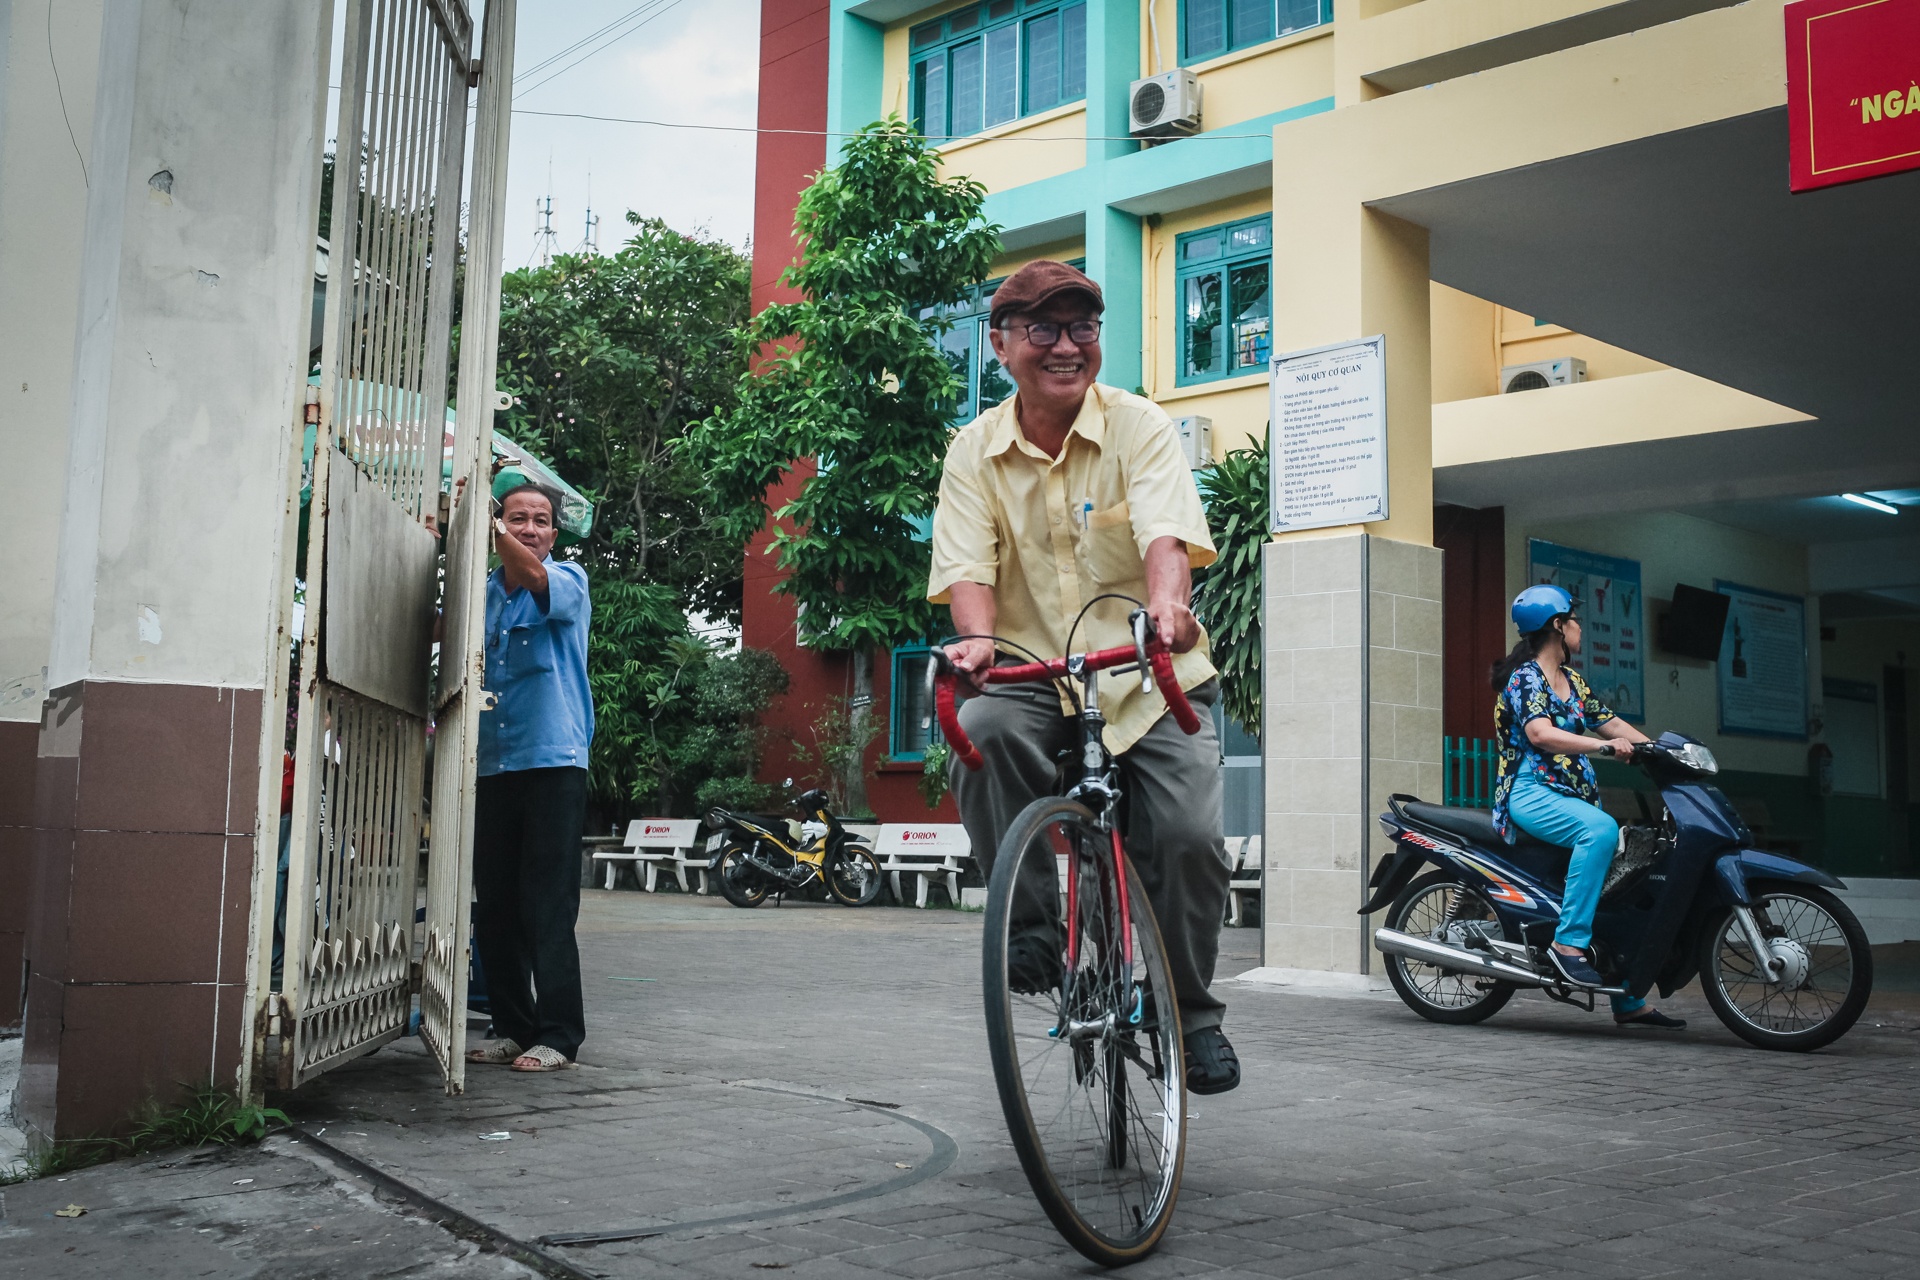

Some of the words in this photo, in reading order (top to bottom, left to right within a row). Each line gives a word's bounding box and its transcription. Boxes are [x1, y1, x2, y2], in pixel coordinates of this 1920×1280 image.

[1296, 373, 1309, 383] NỘI
[1311, 371, 1326, 381] QUY
[1328, 367, 1339, 376] CƠ
[1340, 364, 1361, 376] QUAN
[912, 832, 937, 840] ORION
